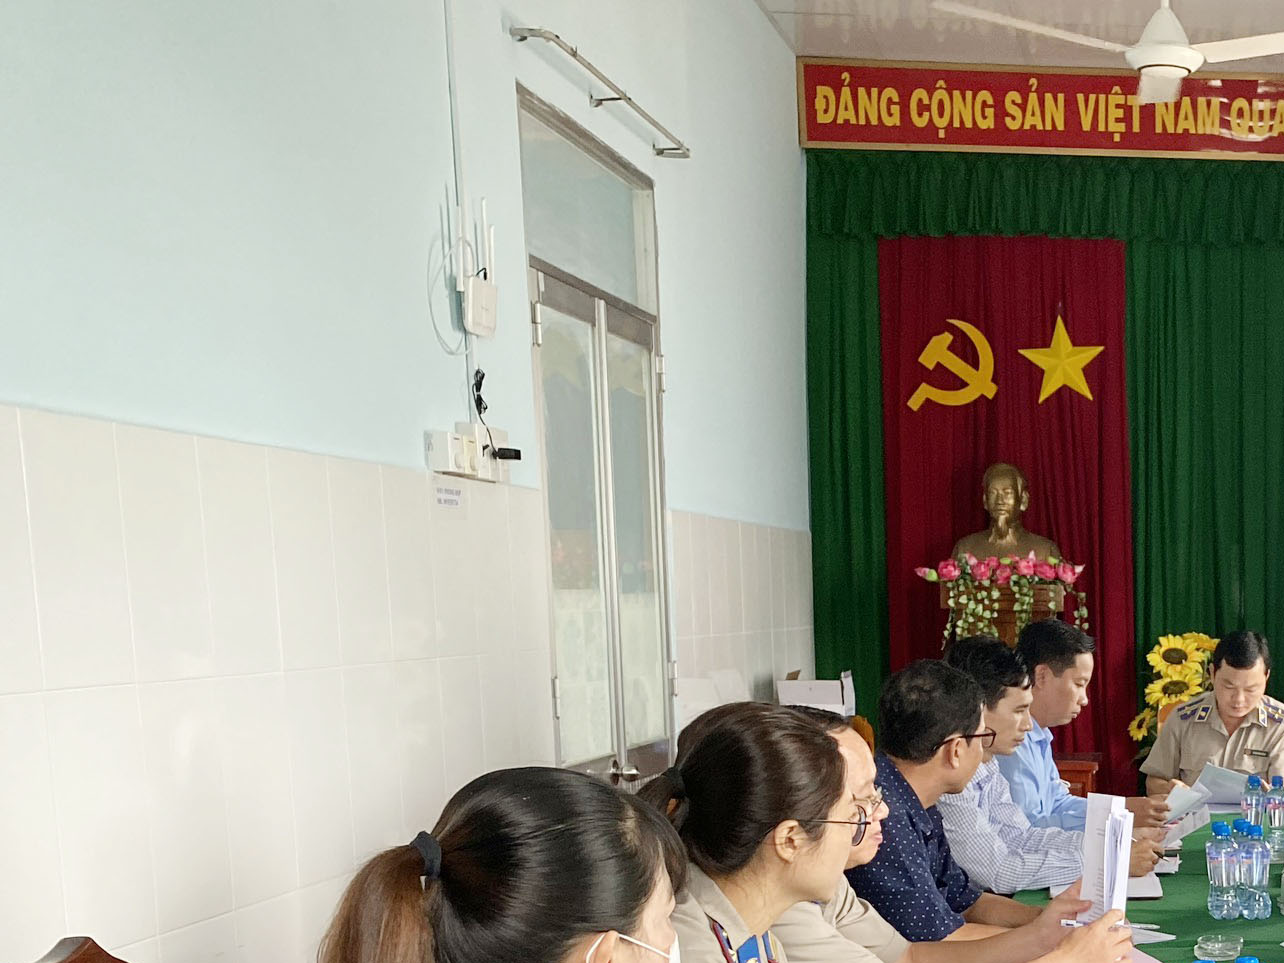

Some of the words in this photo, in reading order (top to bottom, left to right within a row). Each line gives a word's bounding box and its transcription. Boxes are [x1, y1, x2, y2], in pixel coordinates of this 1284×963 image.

[815, 72, 901, 126] ĐẢNG
[909, 79, 995, 138] CỘNG
[1004, 78, 1065, 131] SẢN
[1076, 86, 1143, 142] VIỆT
[1155, 96, 1221, 135] NAM
